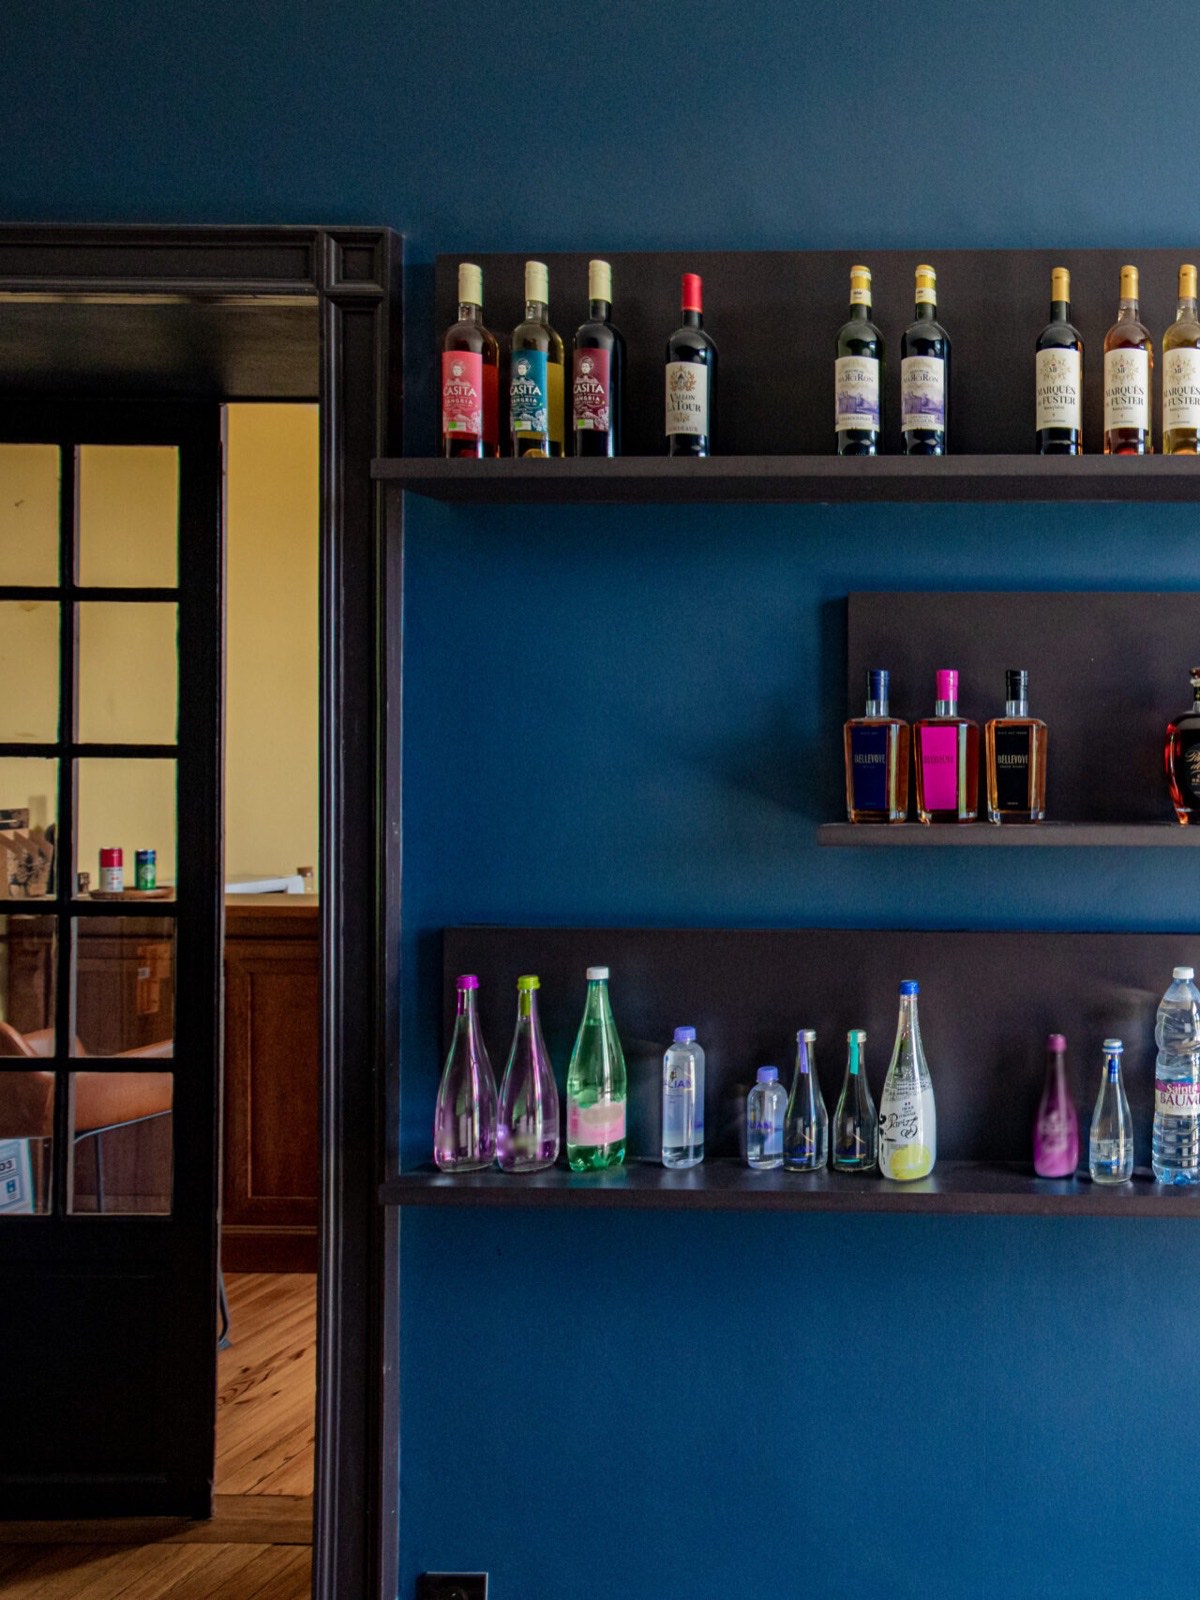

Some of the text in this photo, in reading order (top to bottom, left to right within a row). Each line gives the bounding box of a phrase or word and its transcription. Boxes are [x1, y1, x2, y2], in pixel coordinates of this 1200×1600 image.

[443, 385, 477, 397] CASITA
[510, 384, 541, 396] CASITA
[574, 383, 604, 394] CASITA
[1043, 396, 1076, 405] FUSTER
[1111, 395, 1144, 405] FUSTER
[1168, 396, 1200, 406] FUSTER
[677, 401, 701, 413] TOUR
[1166, 1083, 1197, 1094] Sainte
